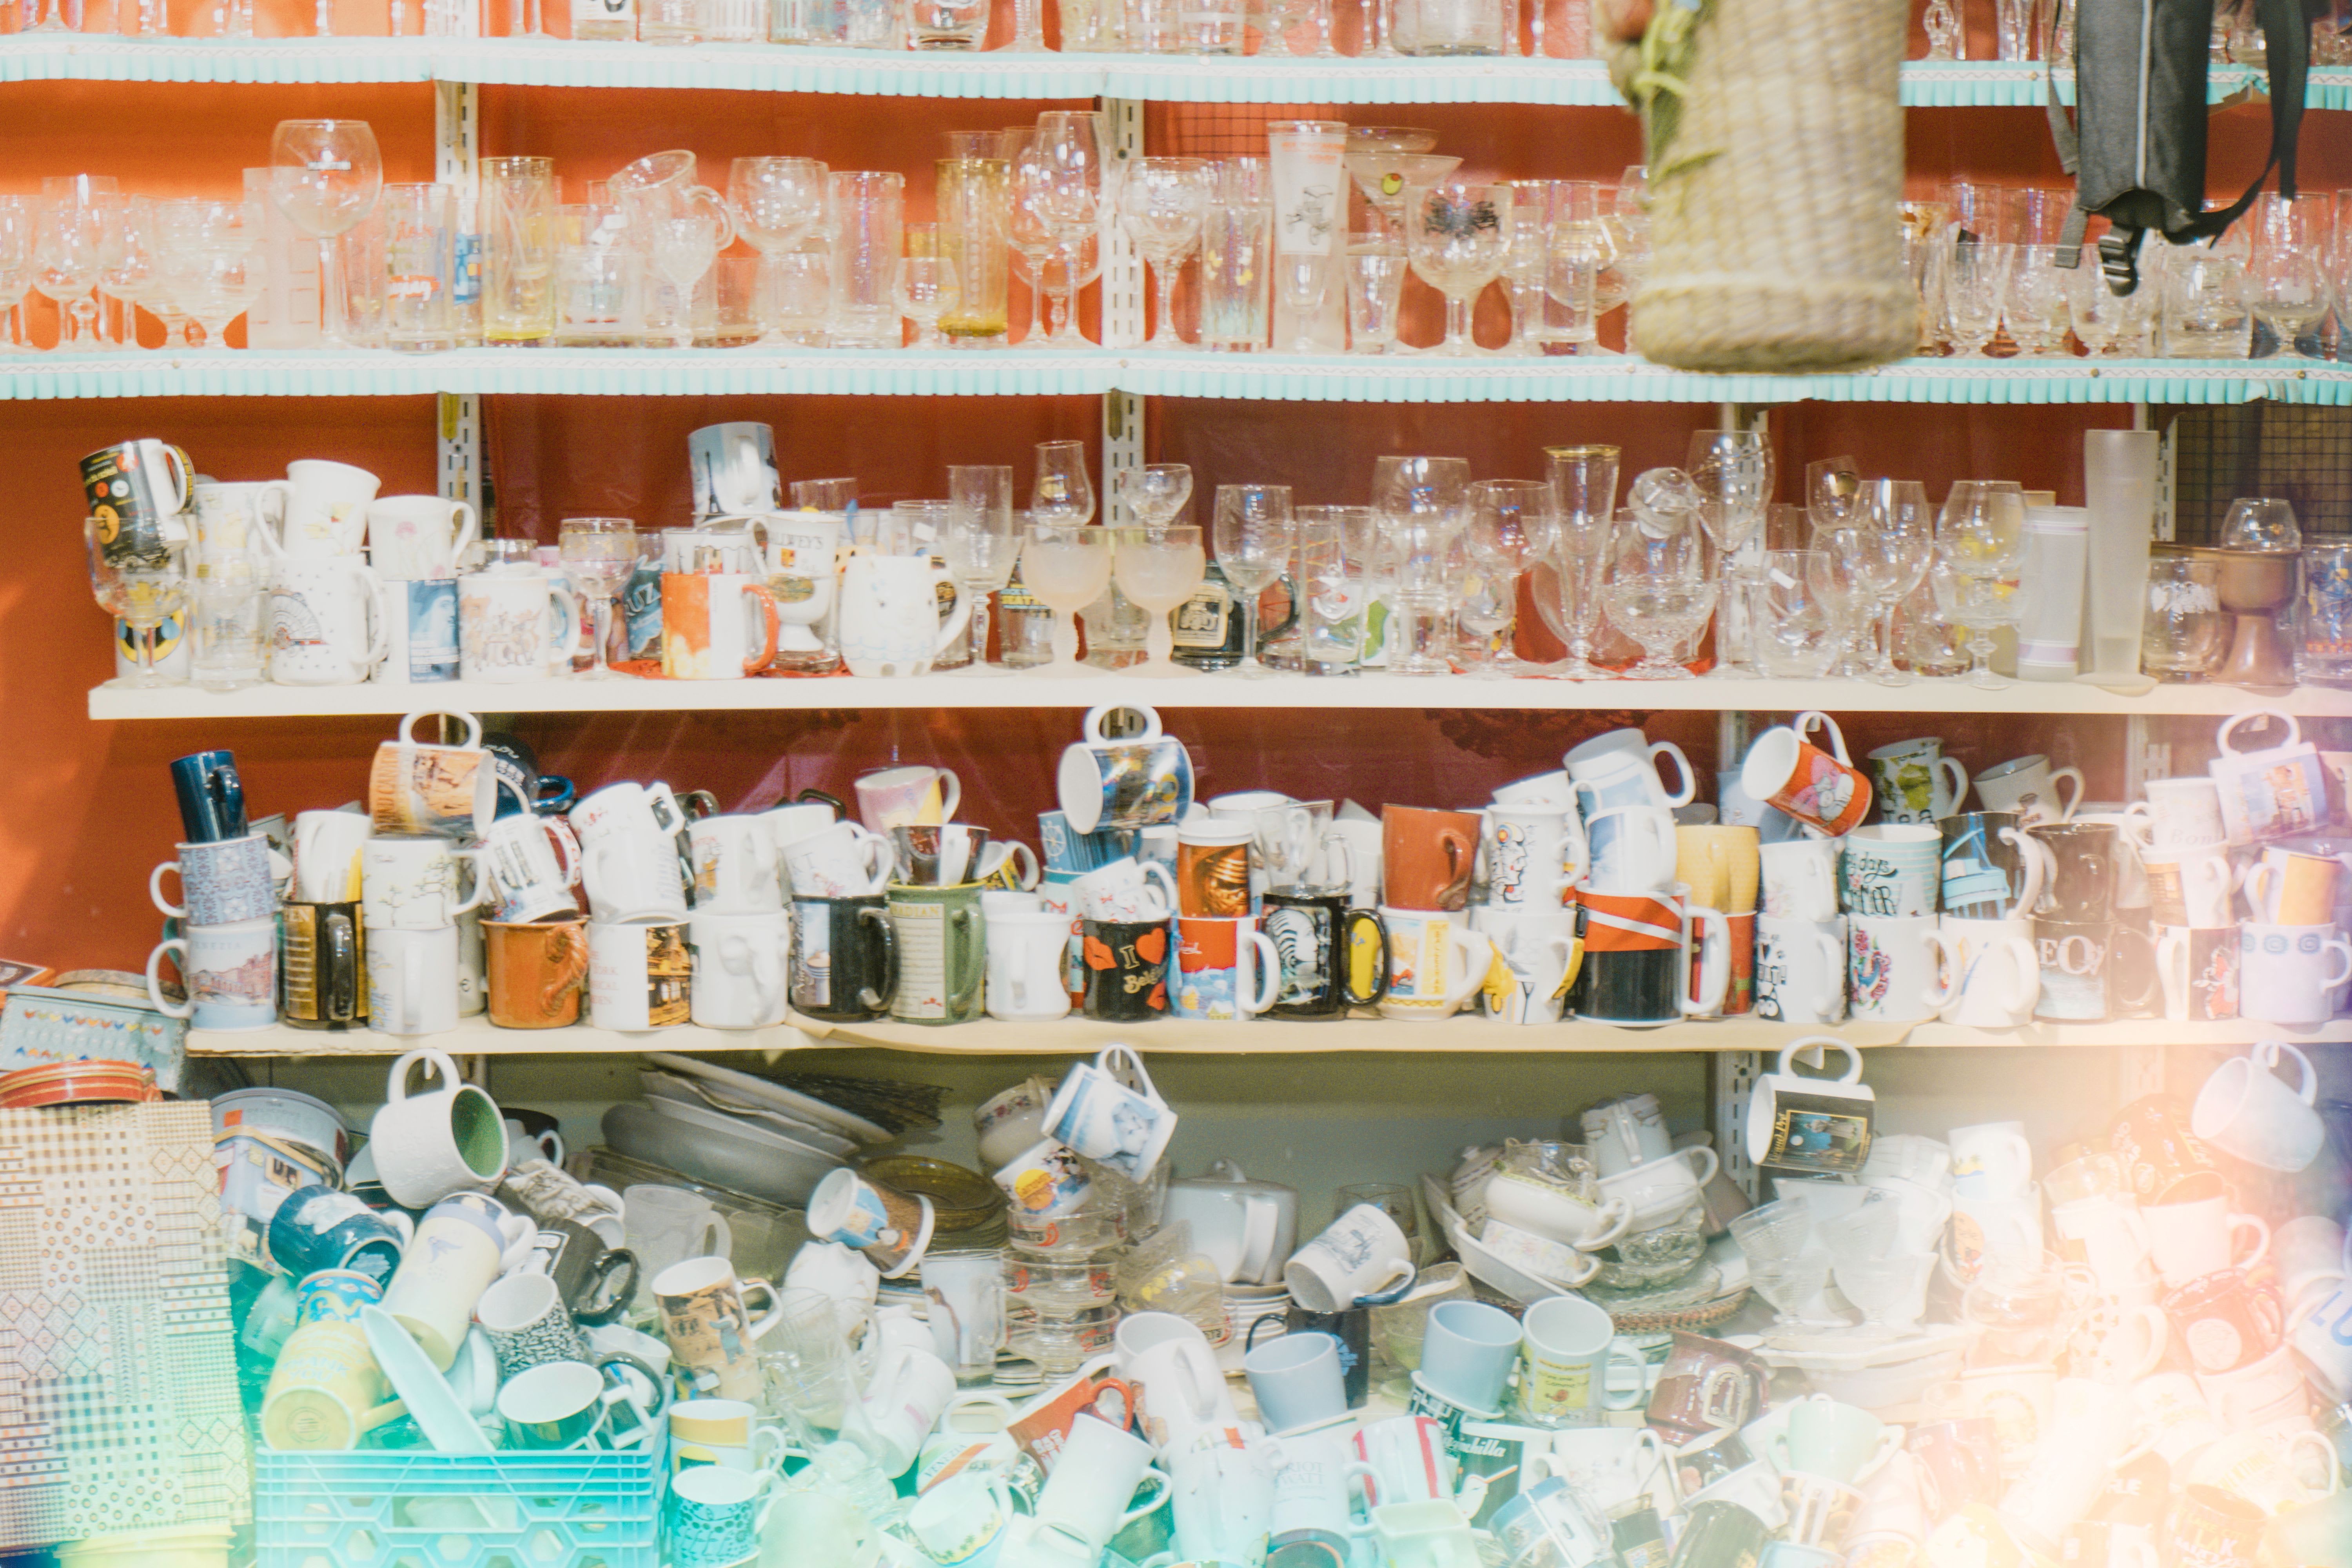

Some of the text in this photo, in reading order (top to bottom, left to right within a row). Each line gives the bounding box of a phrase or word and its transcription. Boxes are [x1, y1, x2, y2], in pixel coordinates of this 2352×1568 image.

[1860, 851, 1898, 884] days
[194, 941, 242, 950] ENEZIA
[1119, 944, 1139, 969] I
[281, 1356, 350, 1378] THANK
[288, 1368, 333, 1383] YOU
